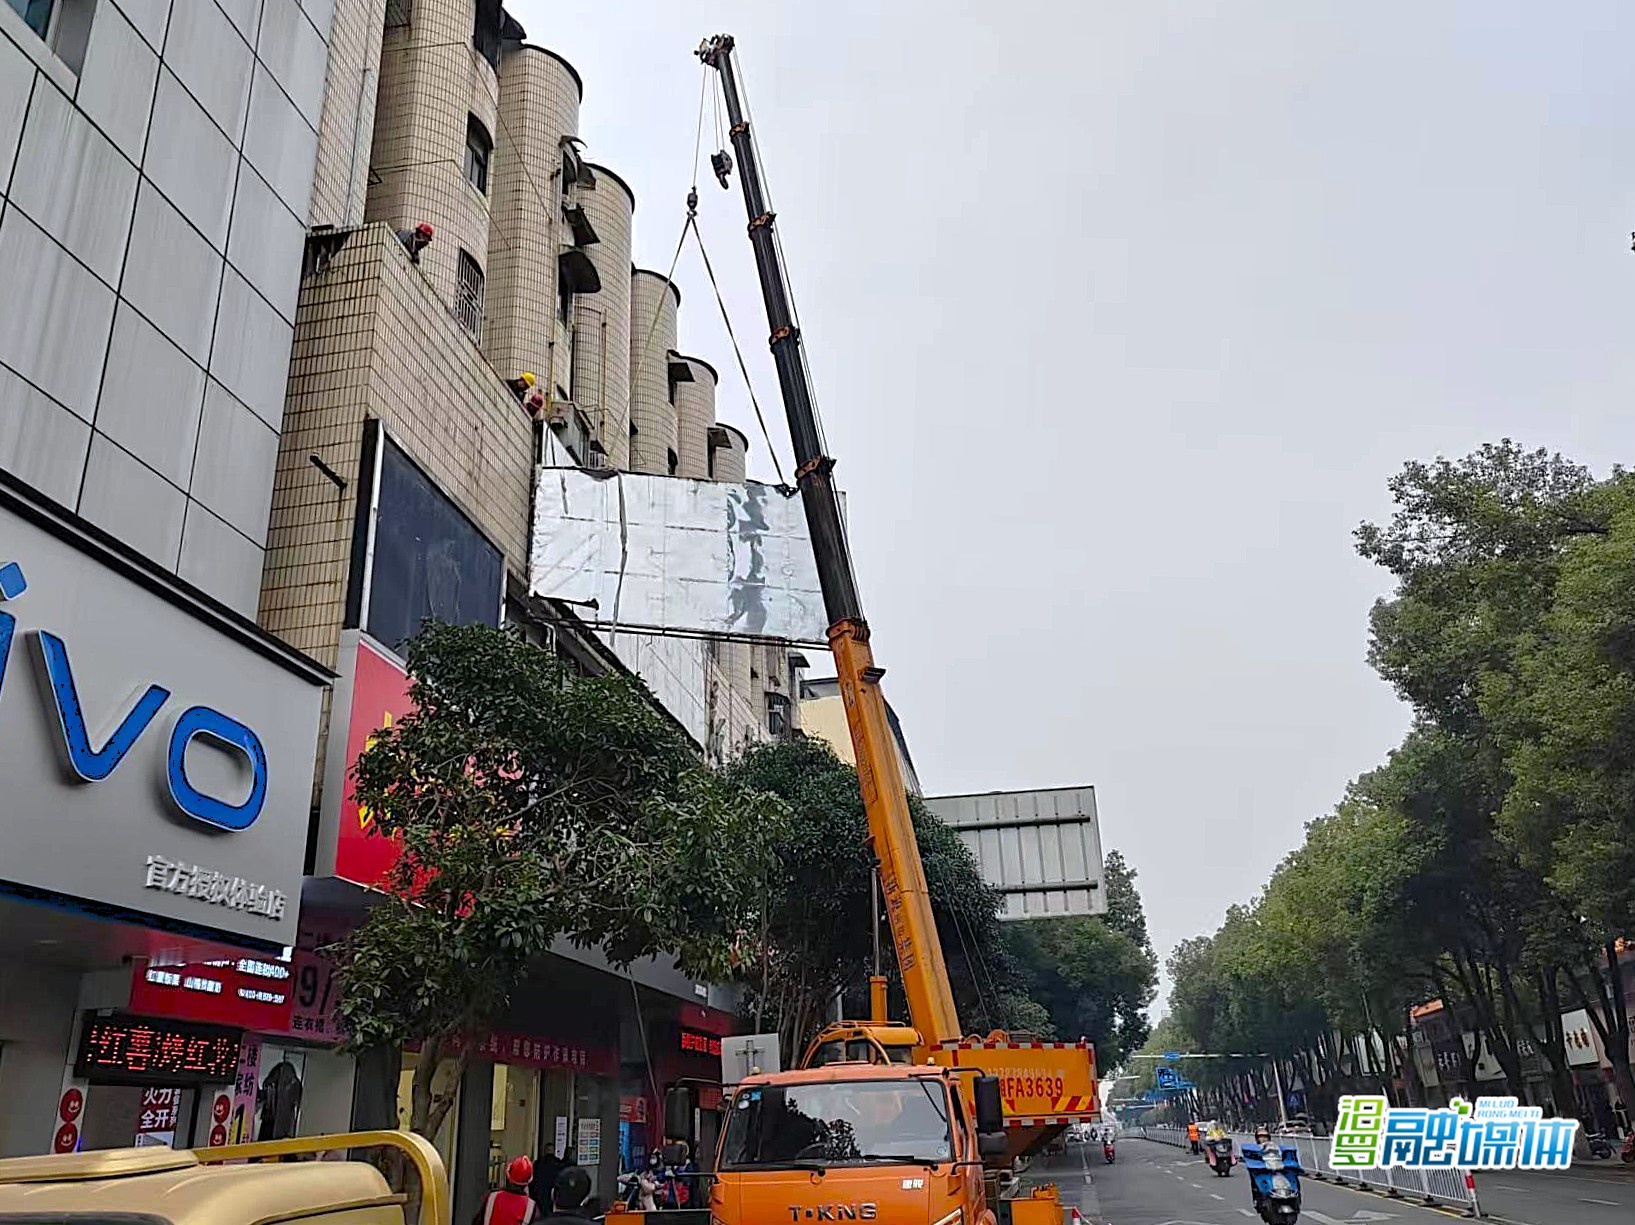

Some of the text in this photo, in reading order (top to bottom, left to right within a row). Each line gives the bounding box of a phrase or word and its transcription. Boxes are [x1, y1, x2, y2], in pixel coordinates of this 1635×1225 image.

[146, 855, 287, 921] 官方授权体验店
[143, 1086, 173, 1105] 火力
[140, 1109, 171, 1129] 全开
